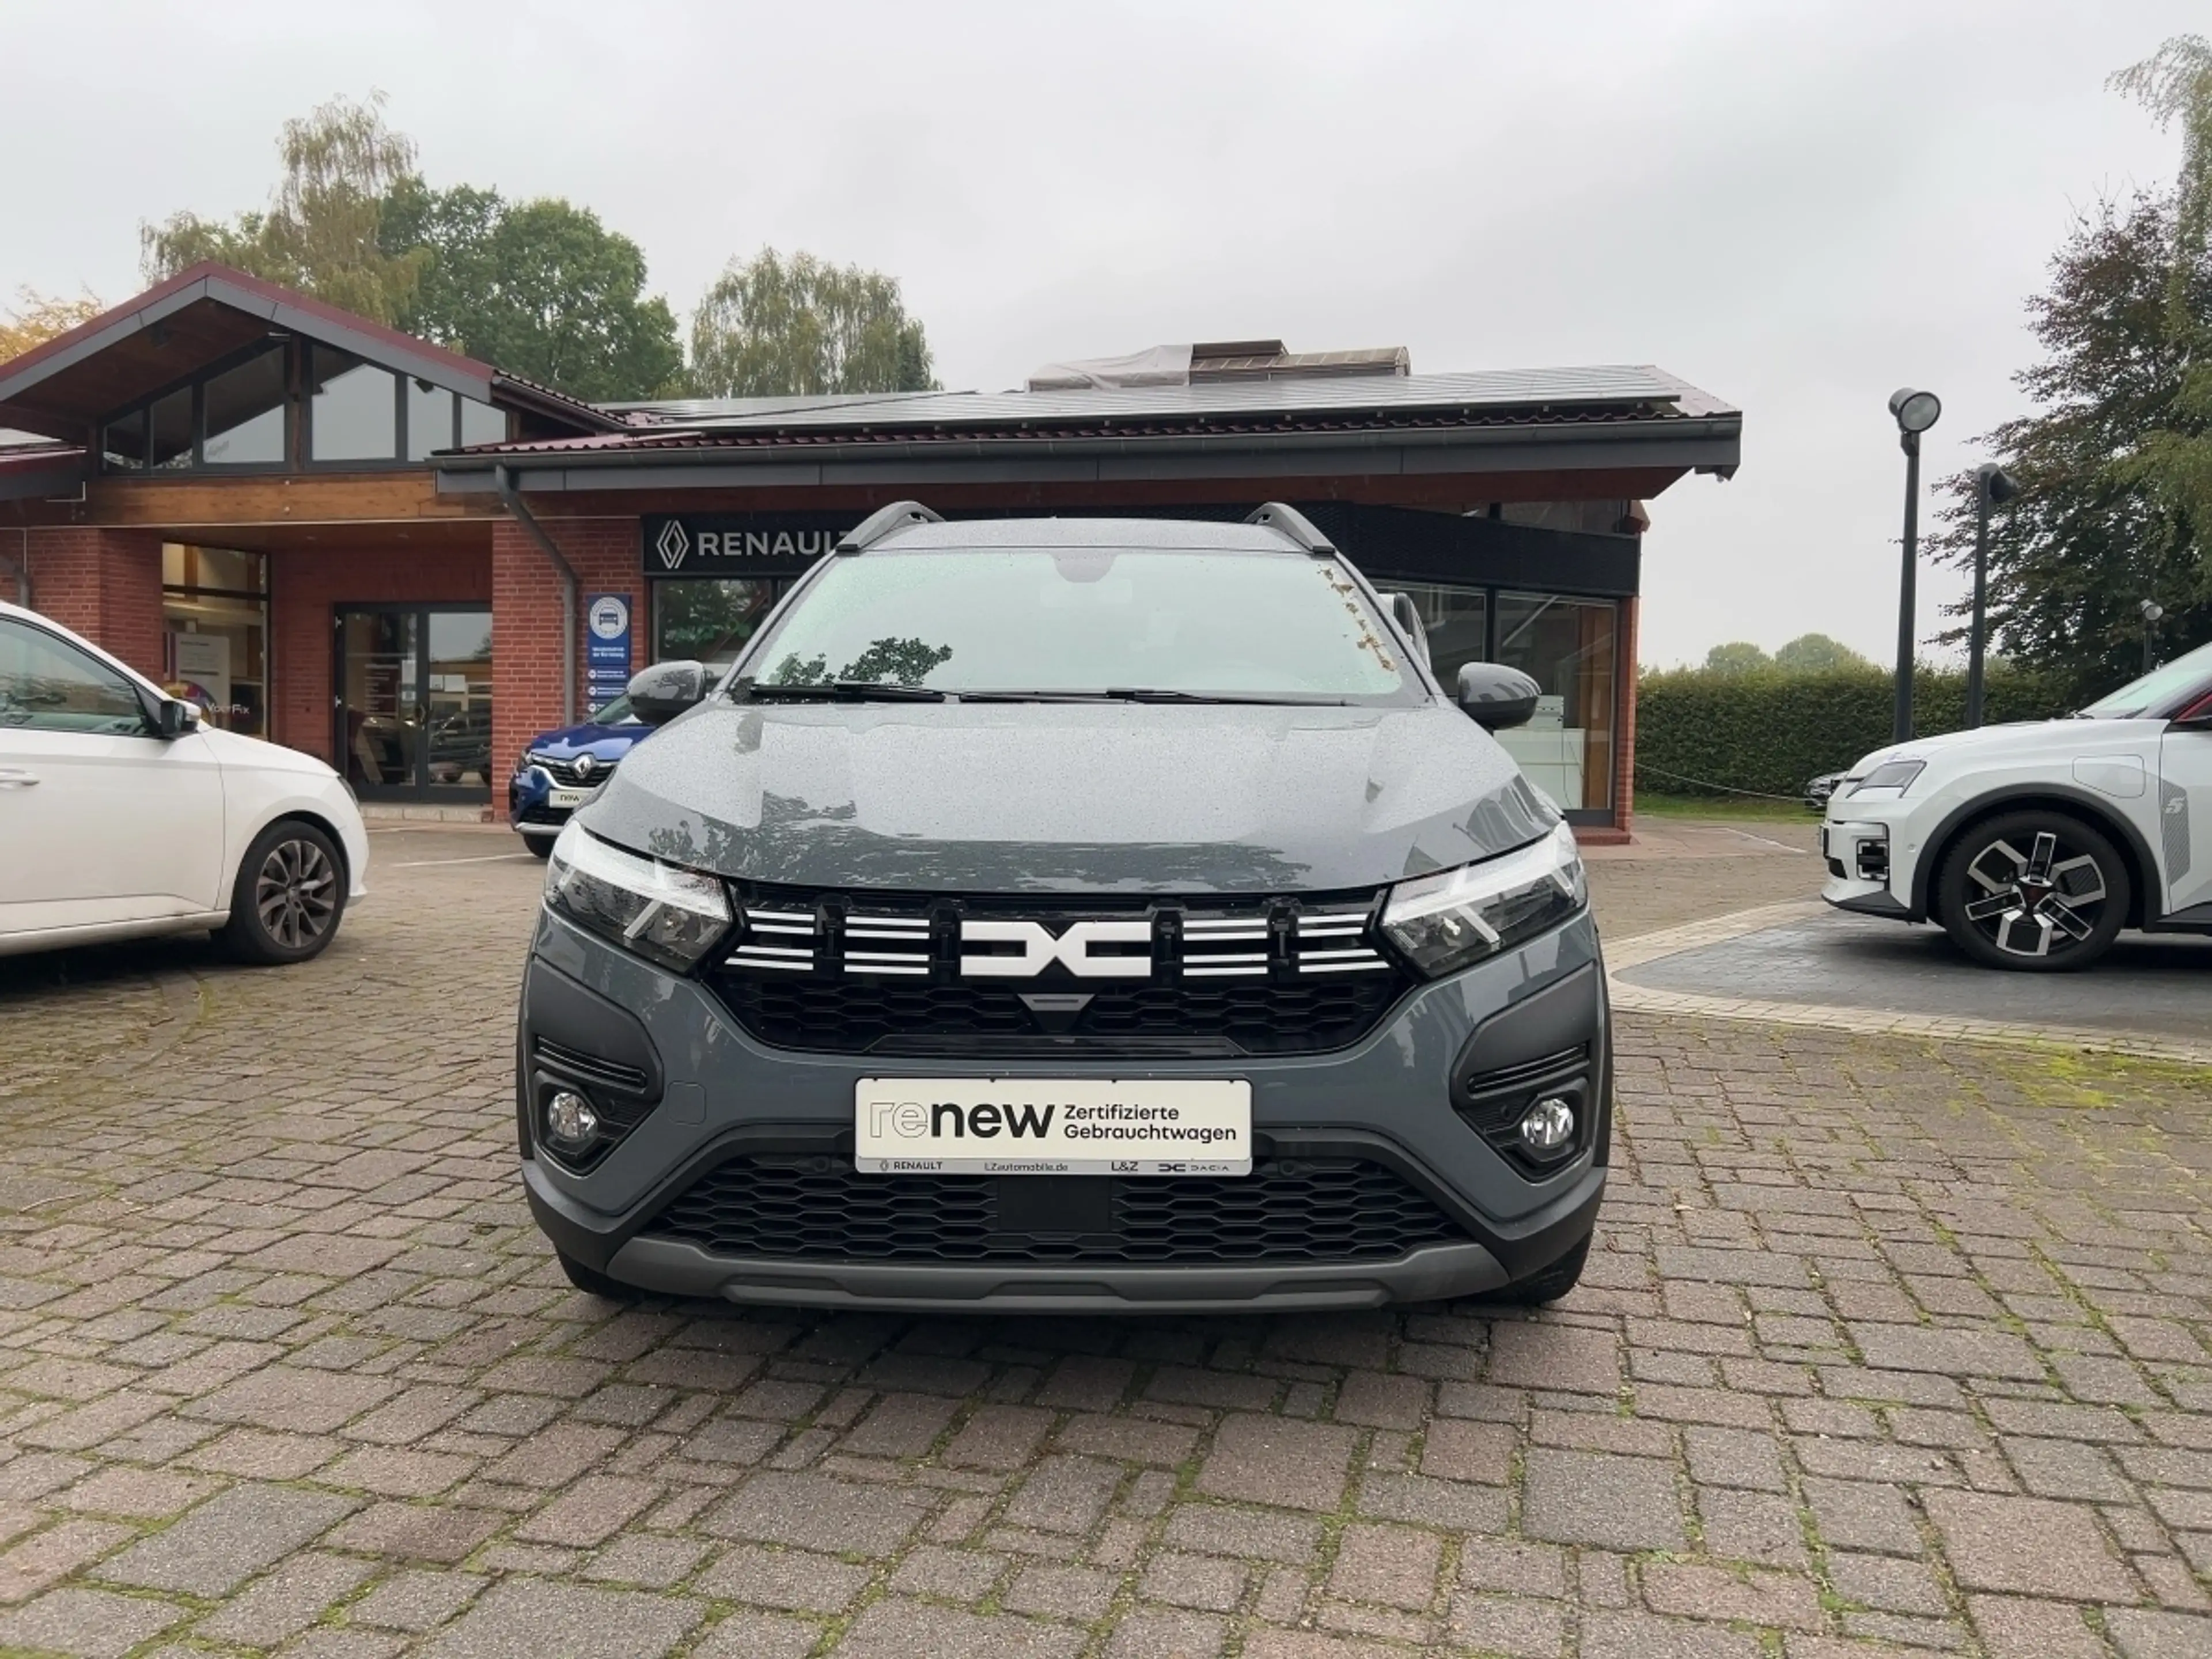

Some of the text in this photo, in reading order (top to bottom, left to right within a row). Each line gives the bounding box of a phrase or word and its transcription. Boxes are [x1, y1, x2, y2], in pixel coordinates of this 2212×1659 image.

[1064, 1104, 1179, 1120] Zertifizierte
[870, 1102, 1055, 1138] renew
[1064, 1123, 1237, 1143] Gebrauchtwagen
[893, 1161, 942, 1170] RENAULT
[984, 1162, 1068, 1172] LZautomobile.de
[1111, 1161, 1139, 1172] L&Z
